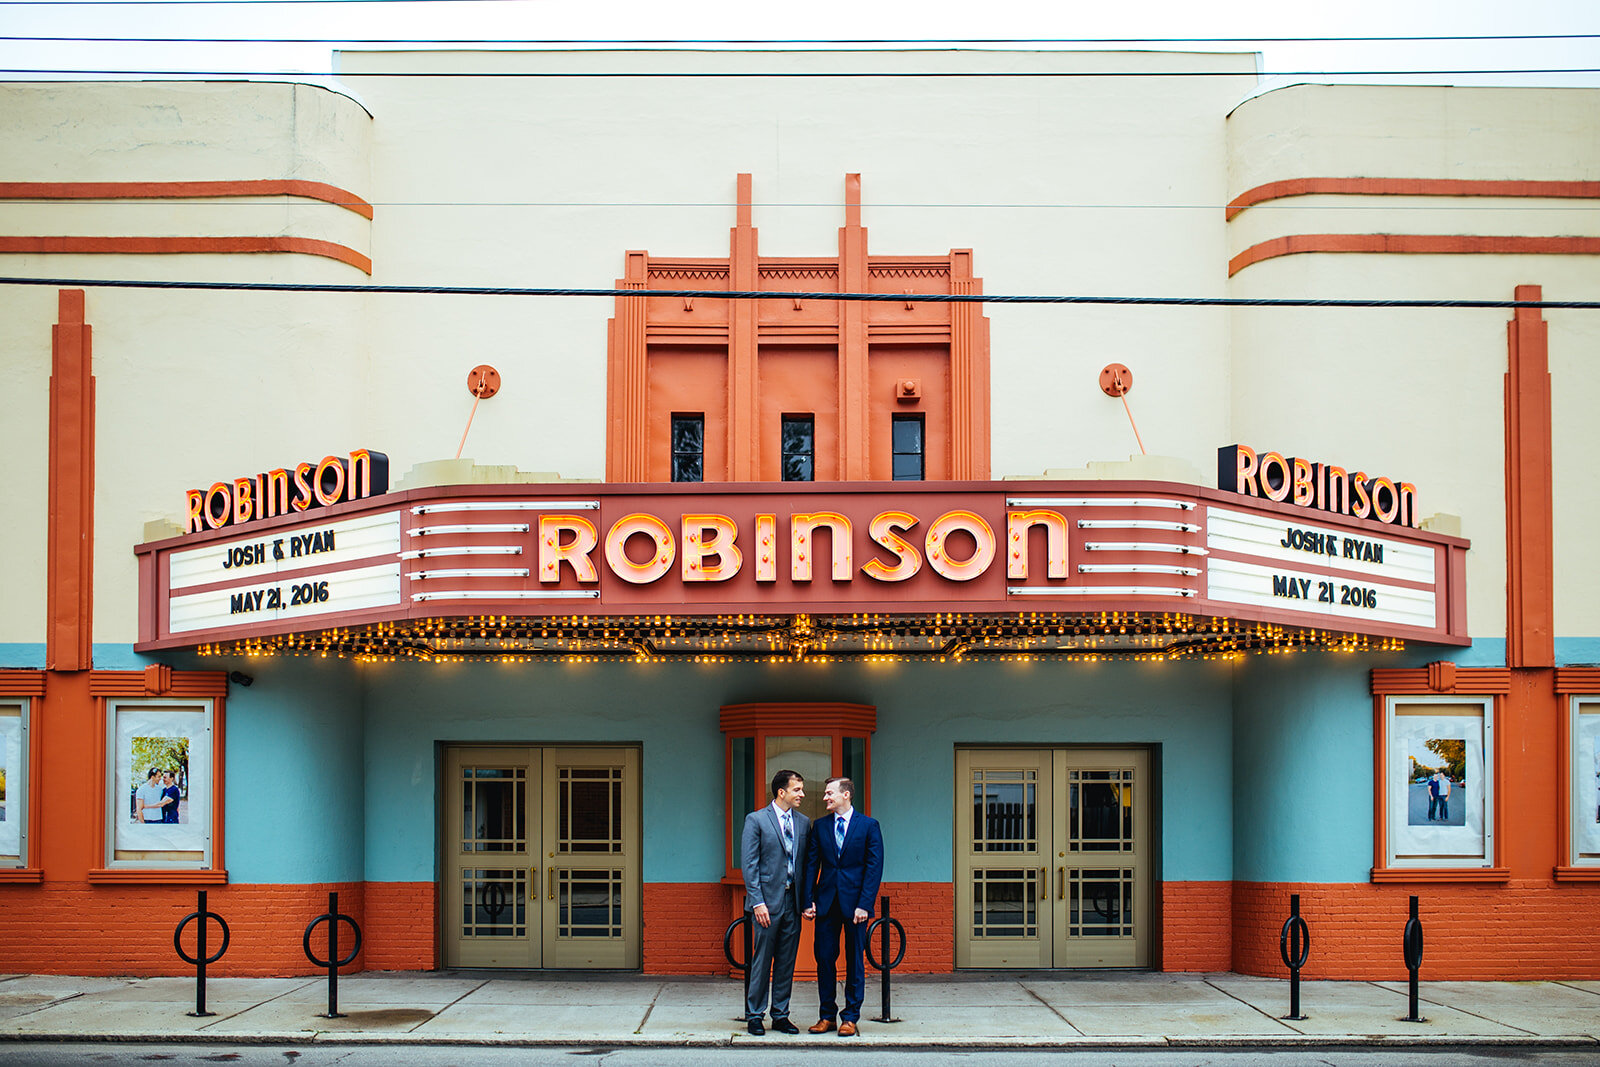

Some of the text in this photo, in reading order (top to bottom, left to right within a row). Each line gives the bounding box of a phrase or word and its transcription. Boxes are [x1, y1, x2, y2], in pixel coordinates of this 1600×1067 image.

[223, 529, 335, 569] JOSH & RYAN
[1343, 537, 1384, 564] RYAN
[230, 581, 329, 614] MAY 21, 2016
[1272, 574, 1377, 609] MAY 21 2016
